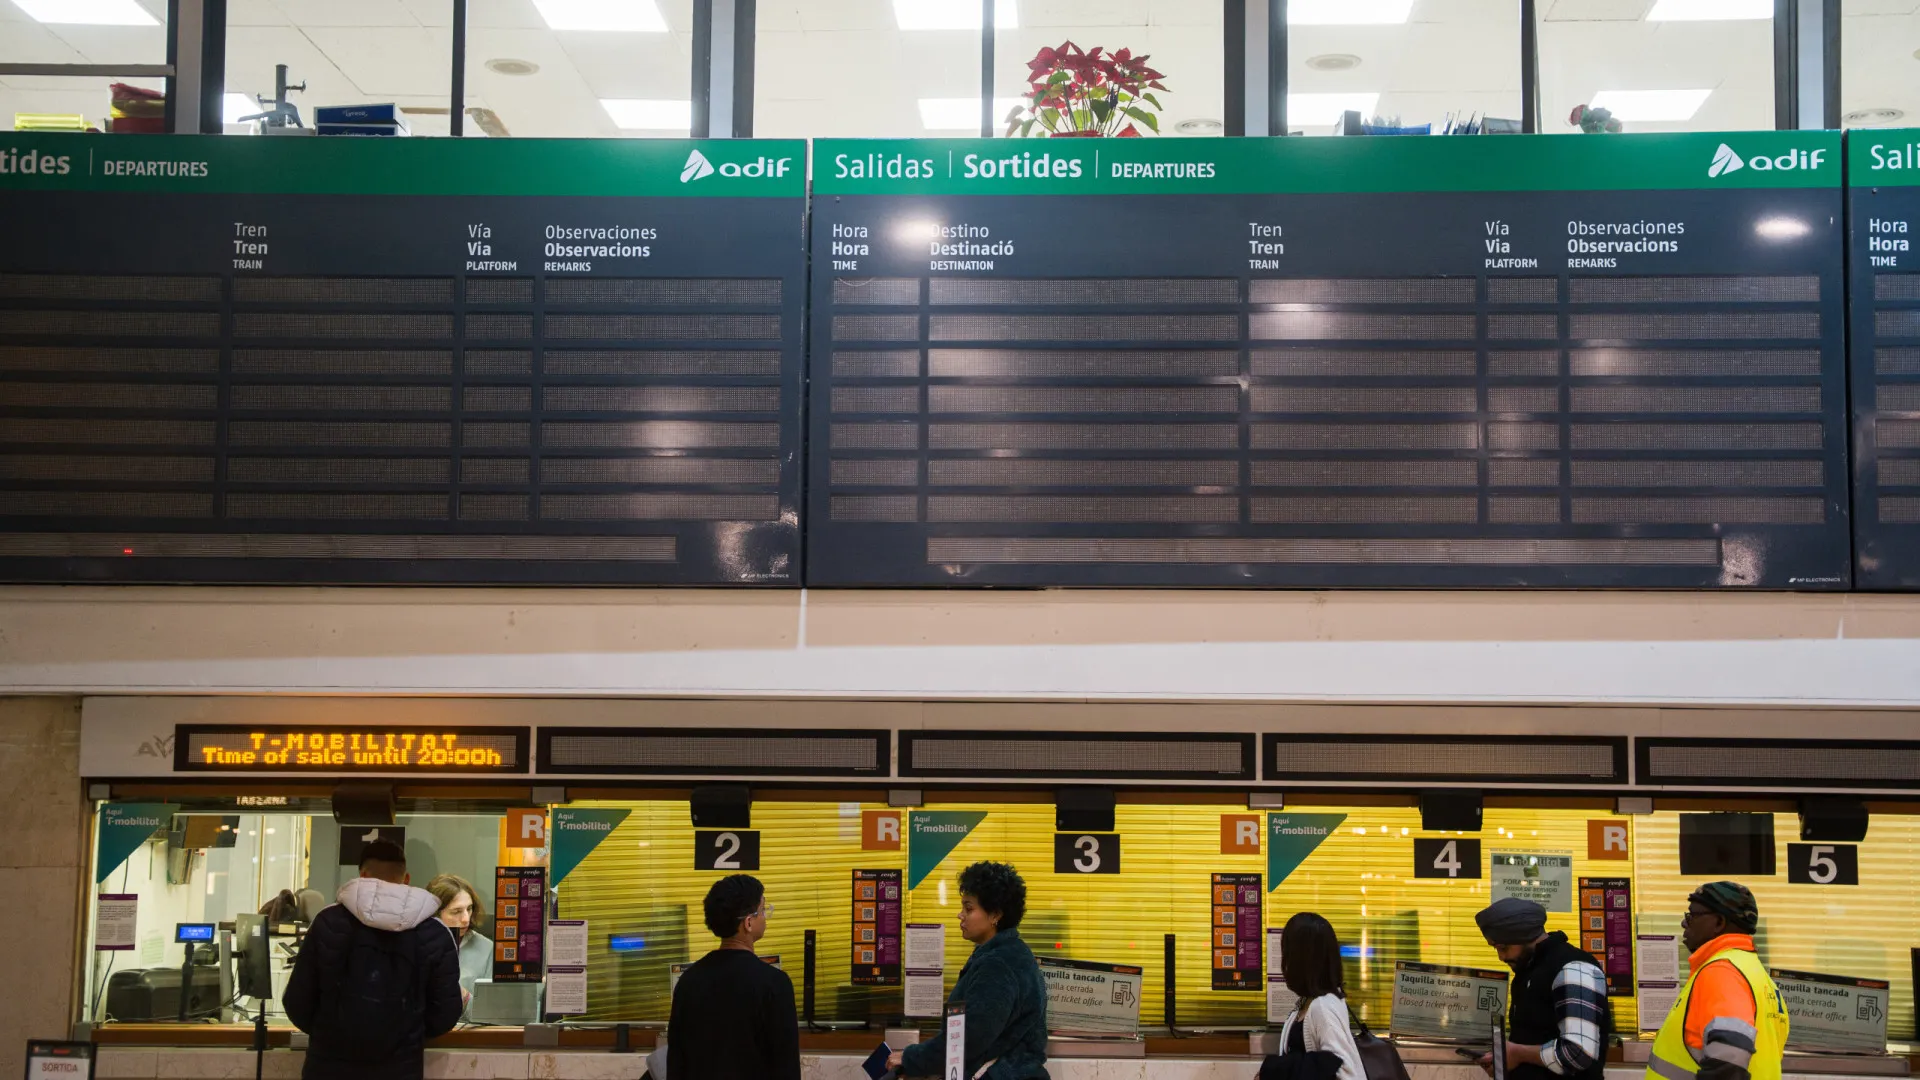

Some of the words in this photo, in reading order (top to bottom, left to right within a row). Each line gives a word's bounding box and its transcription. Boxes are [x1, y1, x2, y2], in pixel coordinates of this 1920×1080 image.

[836, 154, 933, 178] Salidas
[964, 152, 1082, 178] Sortides
[1112, 163, 1215, 177] DEPARTURES
[1749, 149, 1826, 170] adif
[105, 161, 208, 176] DEPARTURES
[719, 157, 791, 177] adif
[235, 223, 266, 236] Tren
[469, 224, 490, 238] Vía
[546, 225, 656, 239] Observaciones
[833, 224, 867, 237] Hora
[931, 224, 989, 237] Destino
[1249, 223, 1281, 236] Tren
[1486, 221, 1509, 235] Vía
[1568, 221, 1684, 234] Observaciones
[1870, 219, 1907, 232] Hora
[234, 241, 267, 254] Tren
[468, 242, 491, 255] Via
[545, 243, 650, 257] Observacions
[833, 242, 868, 255] Hora
[931, 241, 1013, 256] Destinació
[1249, 241, 1283, 254] Tren
[1486, 239, 1509, 253] Via
[1568, 238, 1678, 252] Observacions
[1870, 237, 1909, 251] Hora
[233, 260, 262, 269] TRAIN
[467, 262, 516, 270] PLATFORM
[545, 262, 591, 271] REMARKS
[833, 261, 857, 270] TIME
[931, 261, 993, 270] DESTINATION
[1249, 260, 1278, 269] TRAIN
[1486, 259, 1537, 268] PLATFORM
[1568, 258, 1616, 267] REMARKS
[1870, 257, 1896, 266] TIME
[250, 733, 457, 749] T-MOBILITAT
[203, 747, 256, 764] Time
[264, 748, 289, 764] of
[296, 748, 346, 764] sale
[354, 748, 409, 764] until
[417, 748, 501, 765] 20:00h
[106, 817, 159, 826] T-mobilitat
[522, 814, 544, 838] R
[558, 820, 611, 830] T-mobilitat
[914, 823, 968, 833] T-mobilitat
[877, 817, 899, 841] R
[1236, 821, 1259, 845] R
[1273, 825, 1328, 835] T-mobilitat
[1603, 826, 1627, 851] R
[714, 833, 741, 869] 2
[1073, 835, 1100, 872] 3
[1433, 840, 1462, 877] 4
[1808, 846, 1838, 883] 5
[1073, 973, 1106, 982] tancada
[1401, 974, 1434, 985] Taquilla
[1438, 978, 1470, 988] tancada
[1066, 984, 1094, 993] cerrada
[1400, 986, 1428, 996] Taquilla
[1430, 989, 1458, 998] cerrada
[1814, 986, 1849, 997] tancada
[1060, 994, 1080, 1003] ticket
[1082, 998, 1103, 1006] office
[1399, 997, 1424, 1006] Closed
[1425, 1000, 1446, 1010] ticket
[1448, 1003, 1468, 1012] office
[1806, 998, 1836, 1008] cerrada
[1802, 1009, 1824, 1018] ticket
[1825, 1012, 1848, 1022] office
